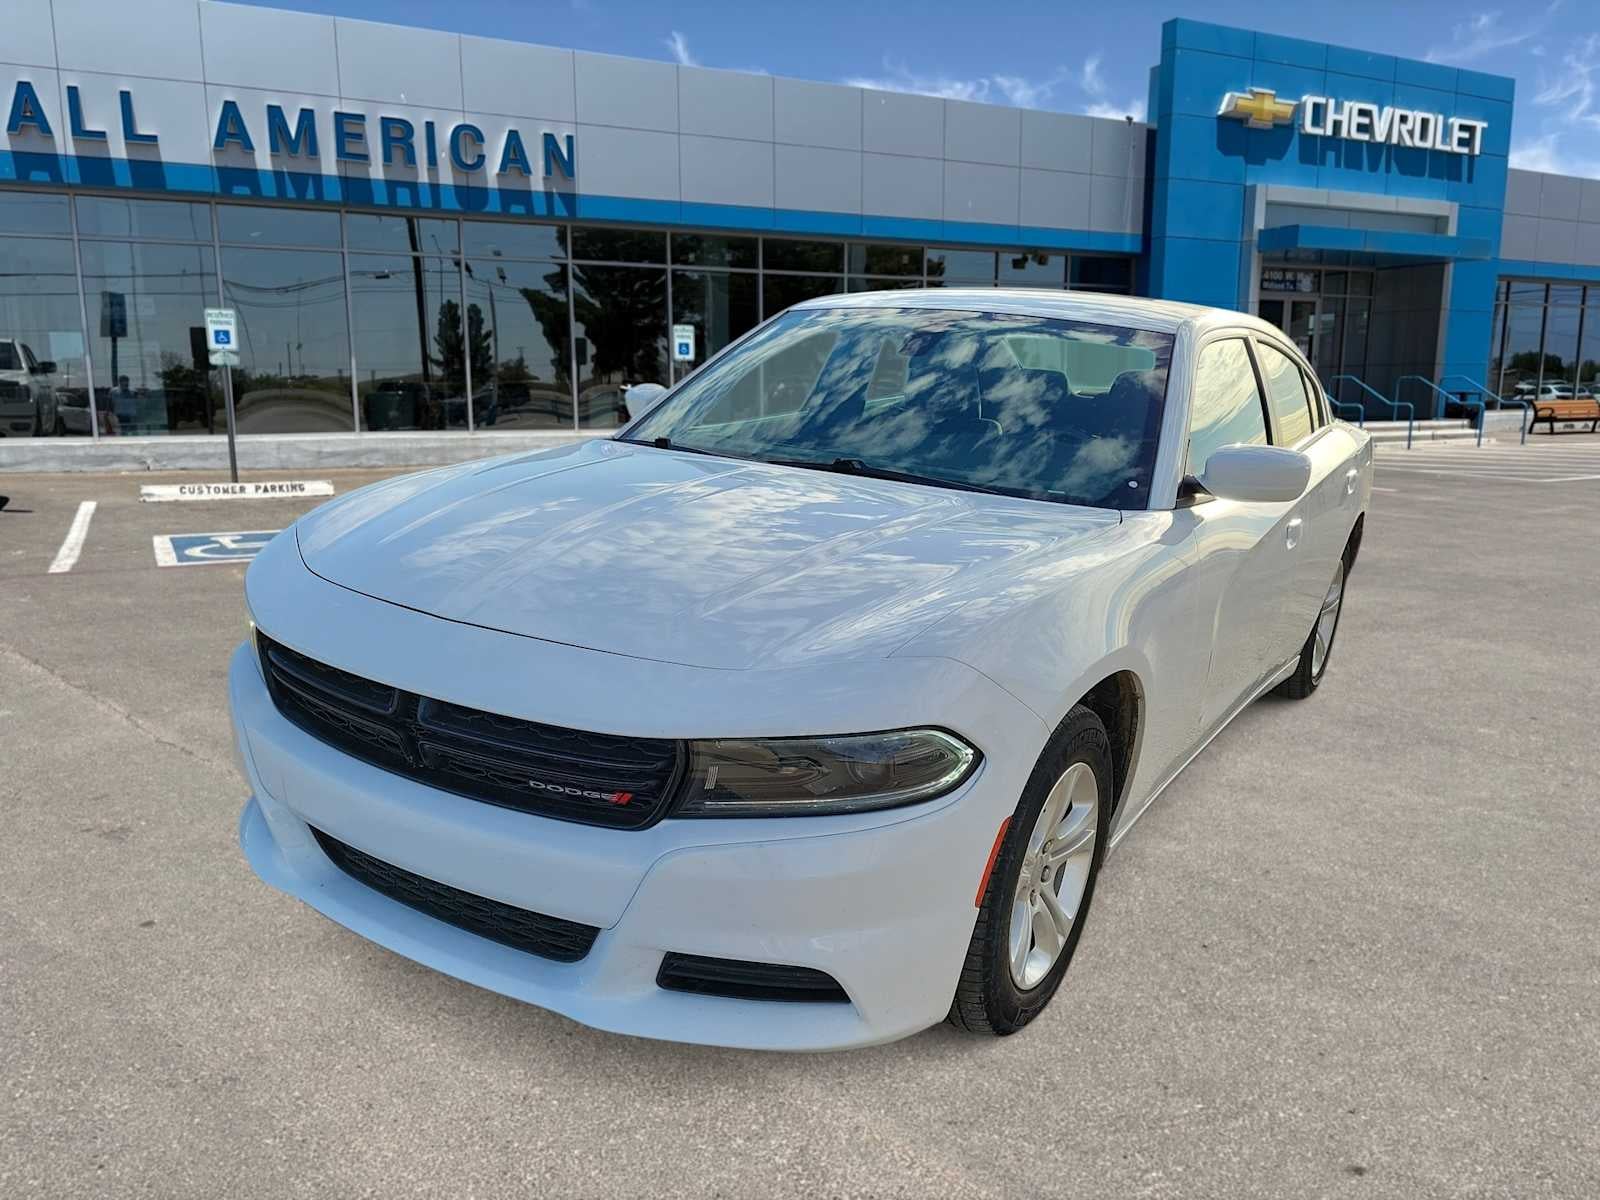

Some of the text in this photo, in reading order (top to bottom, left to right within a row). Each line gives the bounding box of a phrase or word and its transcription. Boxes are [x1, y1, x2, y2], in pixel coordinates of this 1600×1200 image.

[7, 80, 576, 178] ALL AMERICAN
[1301, 94, 1488, 155] CHEVROLET
[179, 483, 305, 495] CUSTOMER PARKING
[528, 779, 618, 801] DODGE
